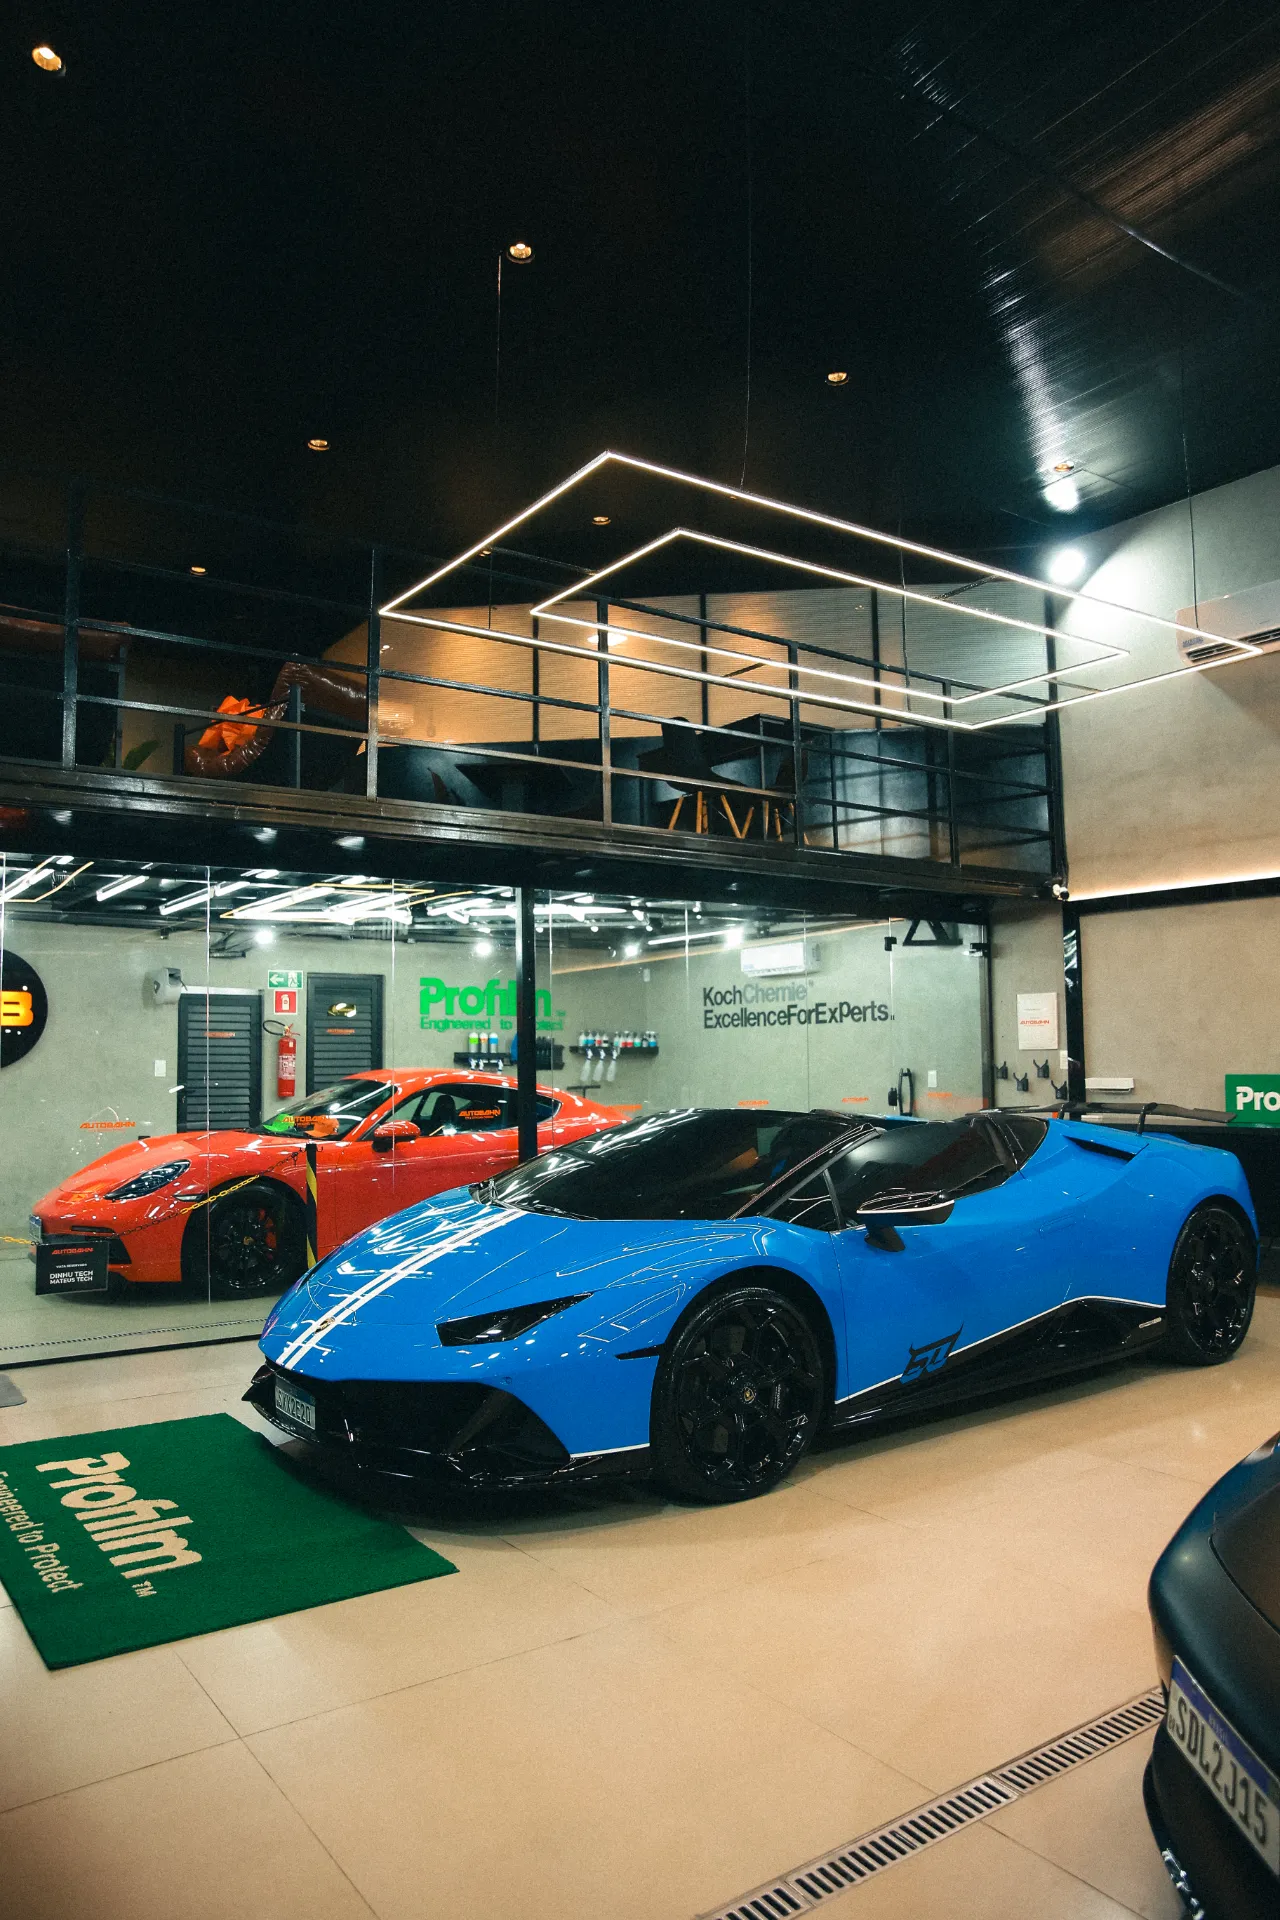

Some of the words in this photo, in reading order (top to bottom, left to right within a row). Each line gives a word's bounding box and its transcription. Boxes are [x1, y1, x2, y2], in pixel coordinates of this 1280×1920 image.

[420, 1016, 491, 1033] Engineered
[500, 1018, 513, 1030] to
[459, 1109, 501, 1117] AUTOBAHN
[80, 1121, 136, 1129] AUTOBAHN
[52, 1247, 94, 1255] AUTOBAHN
[49, 1271, 74, 1280] DINHU
[36, 1451, 203, 1580] Profilm
[17, 1529, 44, 1544] to
[24, 1542, 84, 1594] Protect
[1176, 1695, 1268, 1847] SDL2J15
